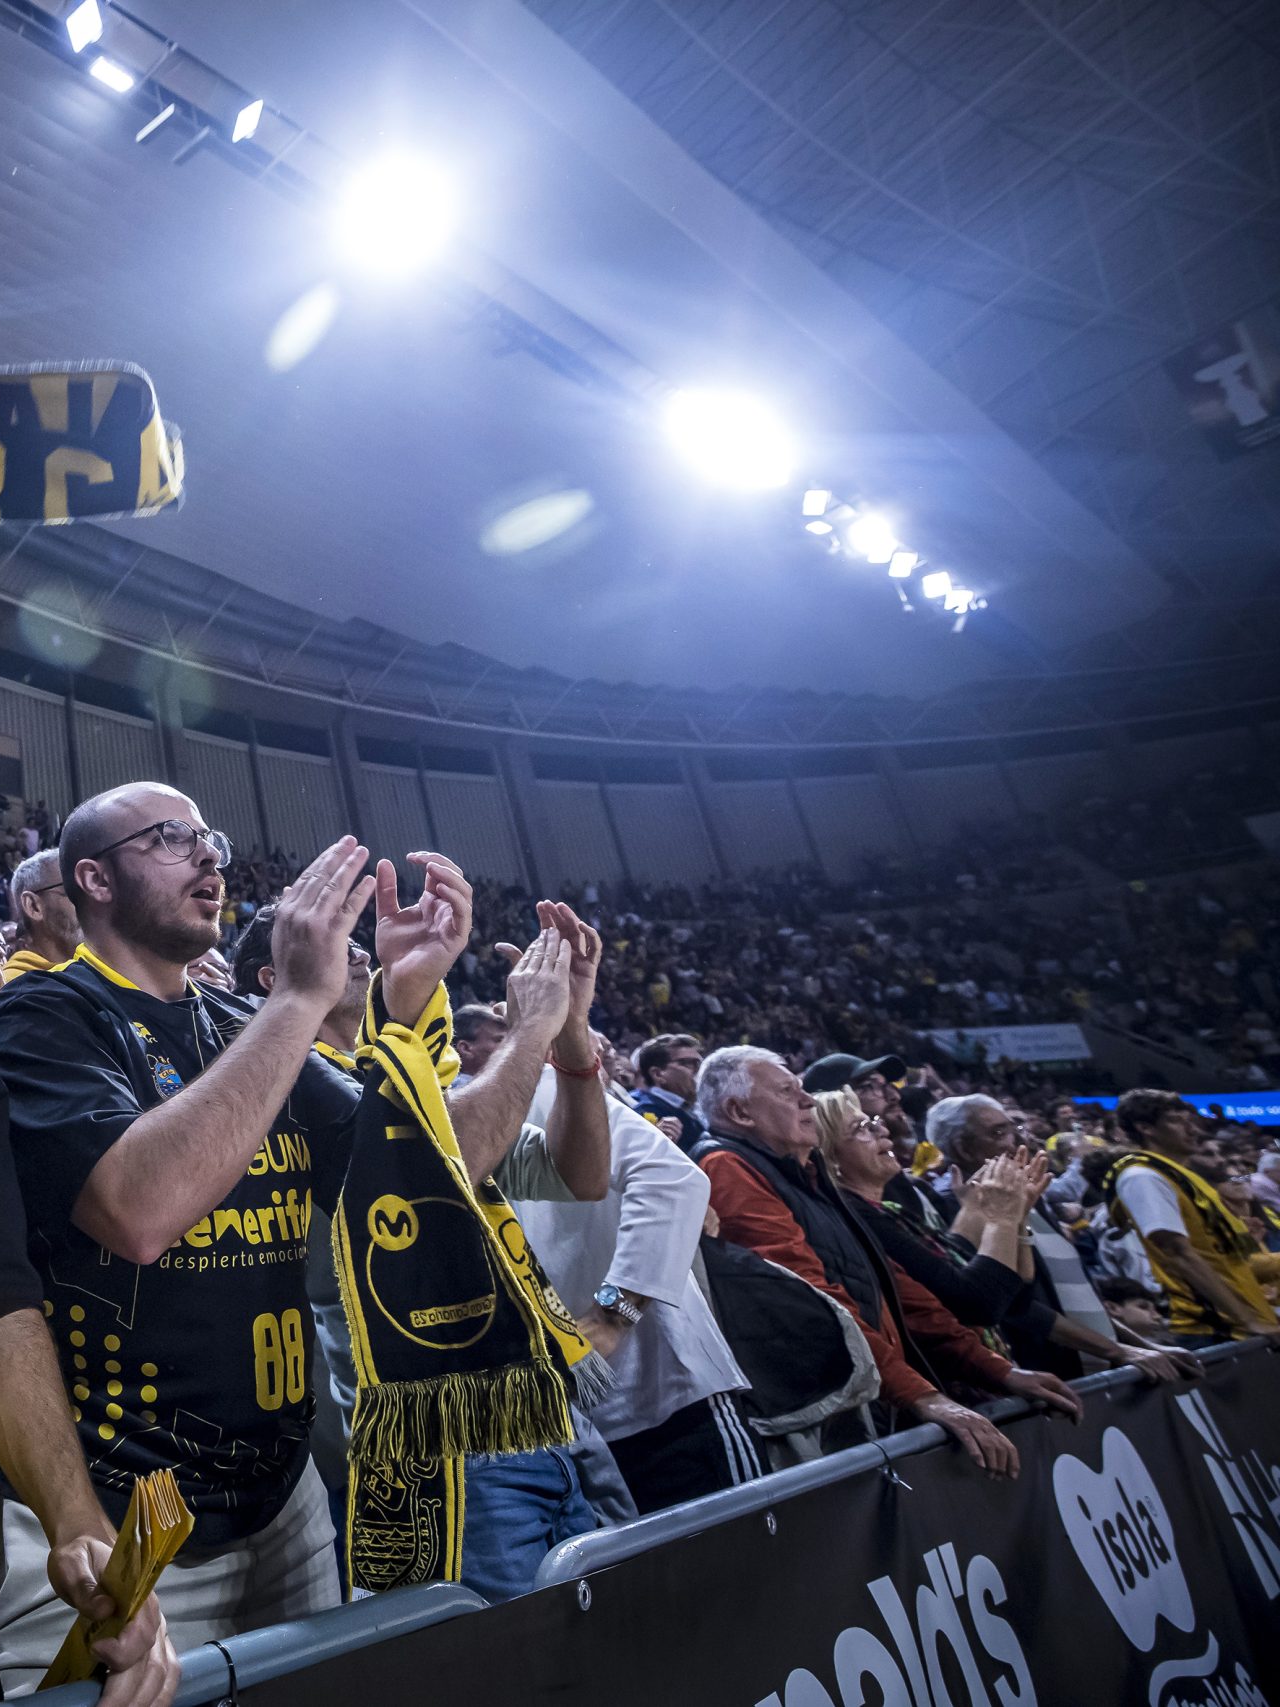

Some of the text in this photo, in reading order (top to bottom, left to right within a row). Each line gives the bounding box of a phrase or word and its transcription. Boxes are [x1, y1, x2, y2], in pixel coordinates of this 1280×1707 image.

[159, 1250, 255, 1273] despierta
[253, 1308, 305, 1411] 88
[1076, 1477, 1172, 1596] isola
